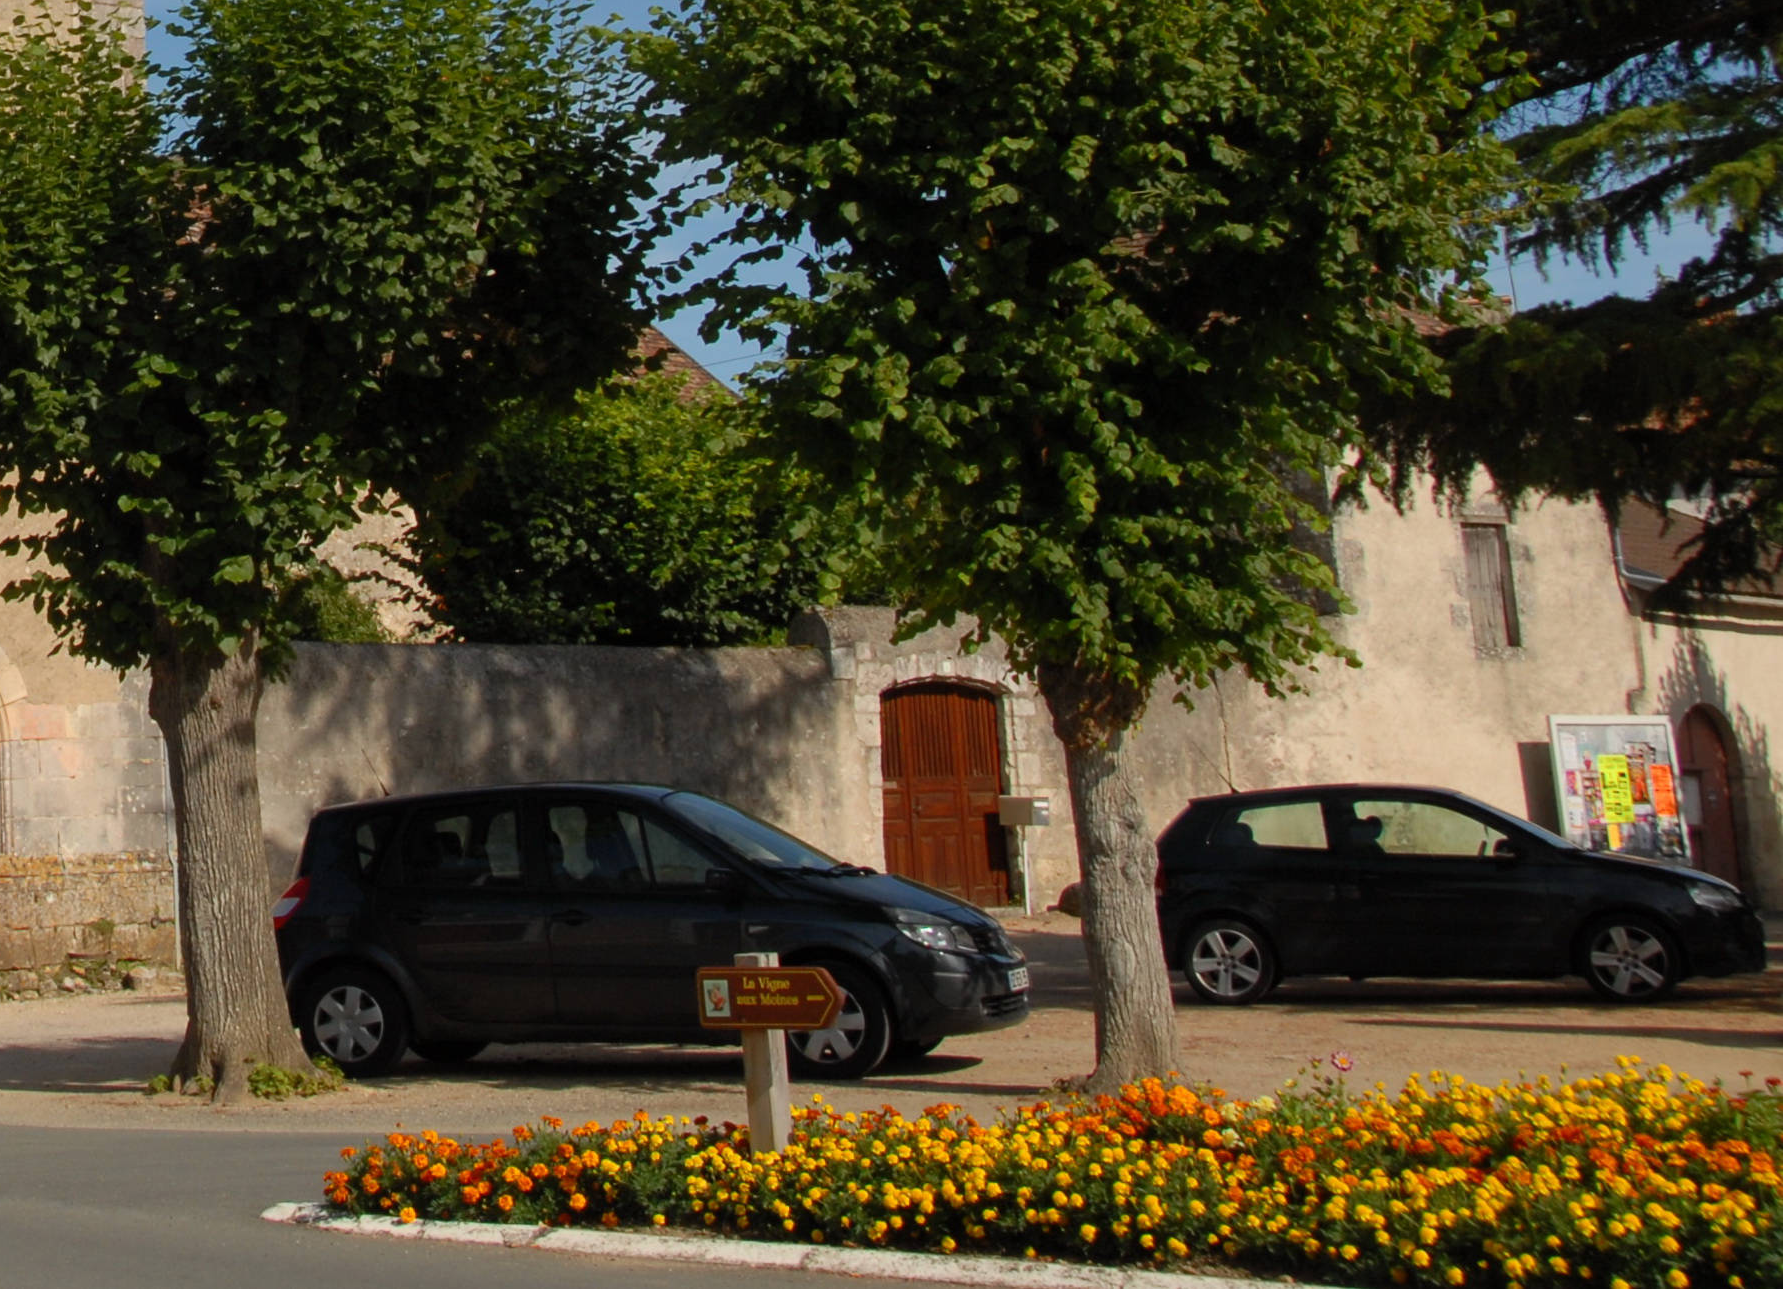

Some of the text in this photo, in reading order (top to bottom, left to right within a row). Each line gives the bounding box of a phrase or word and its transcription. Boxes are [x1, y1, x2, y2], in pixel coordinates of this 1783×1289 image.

[743, 976, 790, 992] La Vigne
[737, 993, 799, 1005] aux Moines
